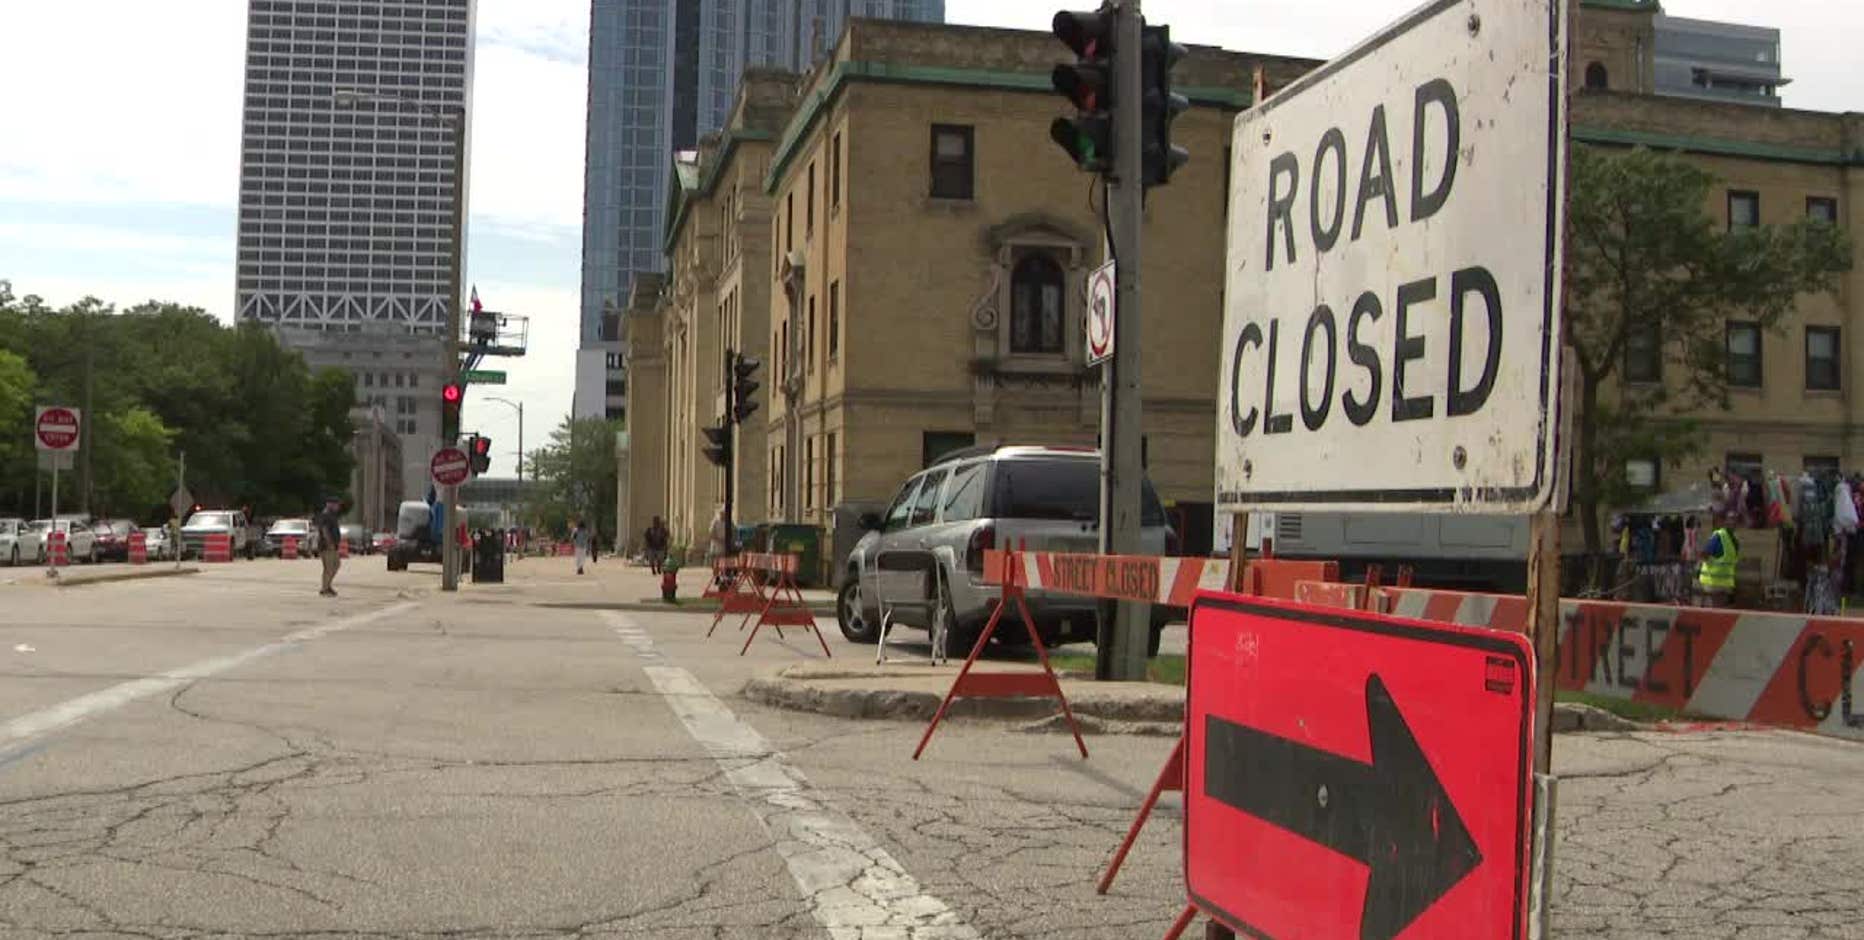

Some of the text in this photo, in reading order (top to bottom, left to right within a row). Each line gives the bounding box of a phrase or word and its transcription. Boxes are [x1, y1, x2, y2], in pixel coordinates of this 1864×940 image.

[1265, 78, 1460, 271] ROAD
[1231, 265, 1503, 438] CLOSED
[1053, 557, 1160, 600] STREET CLOSED
[1555, 610, 1700, 699] TREET
